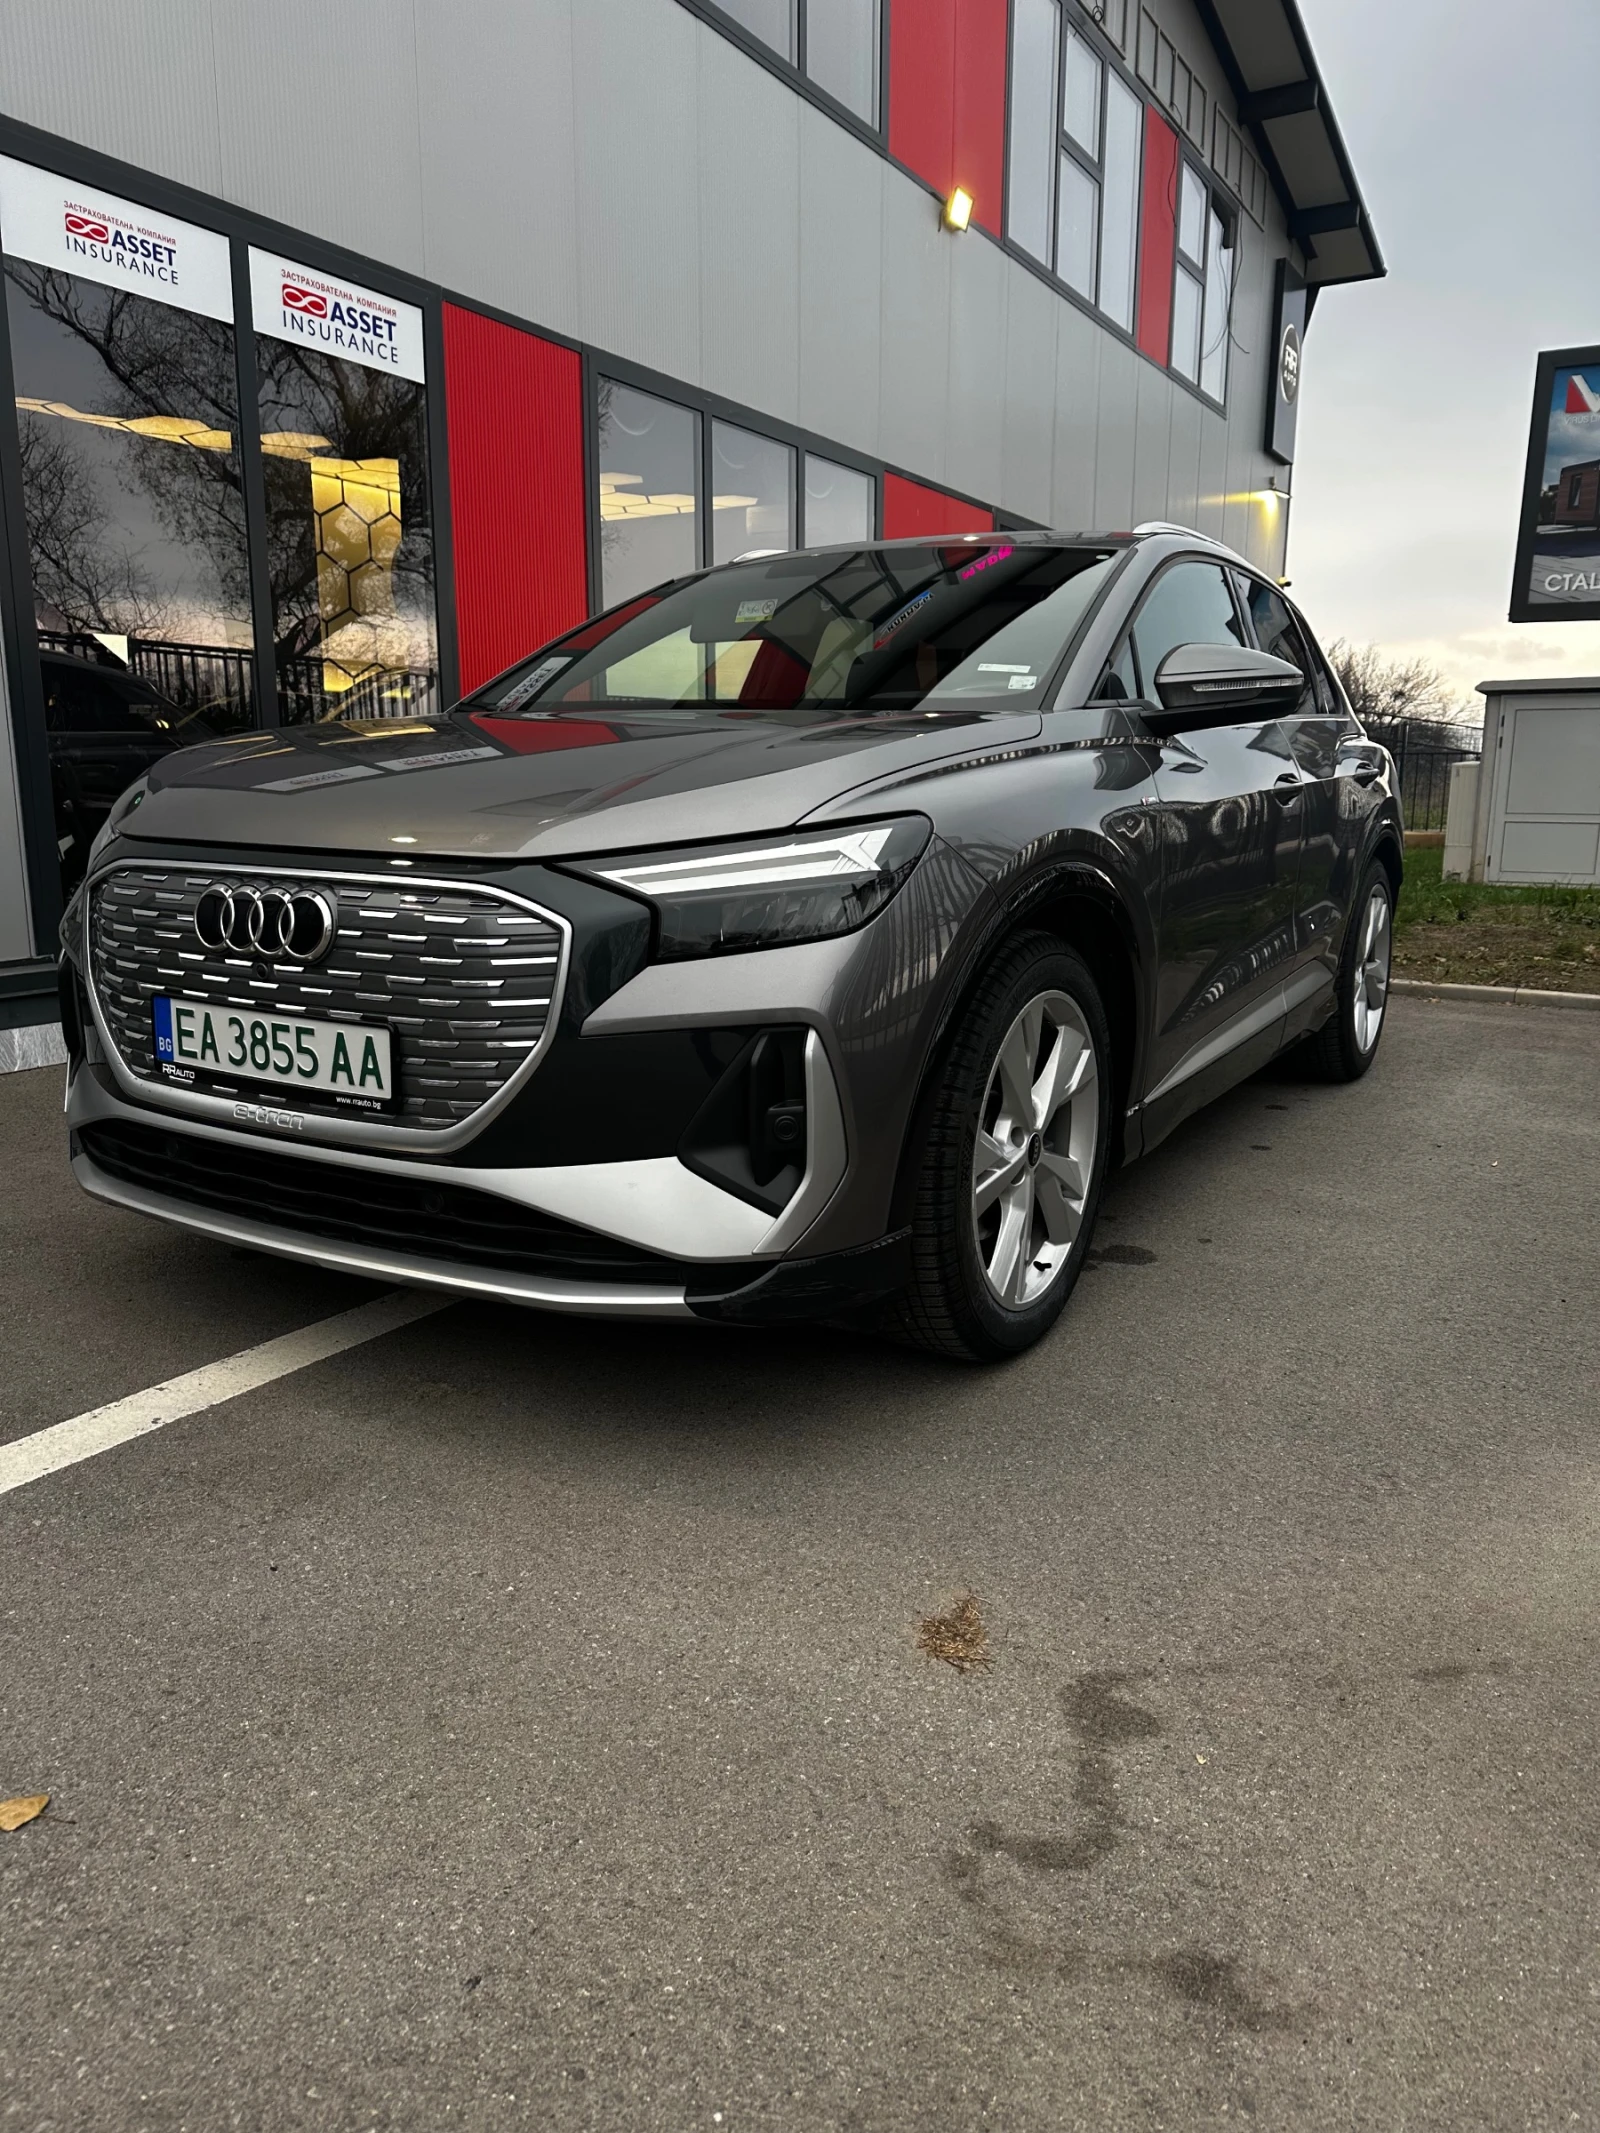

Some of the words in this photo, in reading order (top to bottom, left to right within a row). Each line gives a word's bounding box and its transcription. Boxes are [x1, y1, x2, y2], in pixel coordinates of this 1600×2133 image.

[63, 200, 134, 231] ЗАСТРАХОВАТЕЛНА
[137, 226, 176, 246] КОМПАНИЯ
[65, 234, 179, 285] INSURANCE
[111, 229, 177, 266] ASSET
[281, 268, 354, 303] ЗАСТРАХОВАТЕЛНА
[356, 296, 397, 318] КОМПАНИЯ
[282, 310, 399, 364] INSURANCE
[330, 301, 397, 341] ASSET
[158, 1036, 172, 1053] BG
[175, 1006, 221, 1064] EA
[228, 1015, 320, 1079] 3855
[330, 1030, 384, 1091] AA
[335, 1096, 382, 1110] www.rrauto.bg
